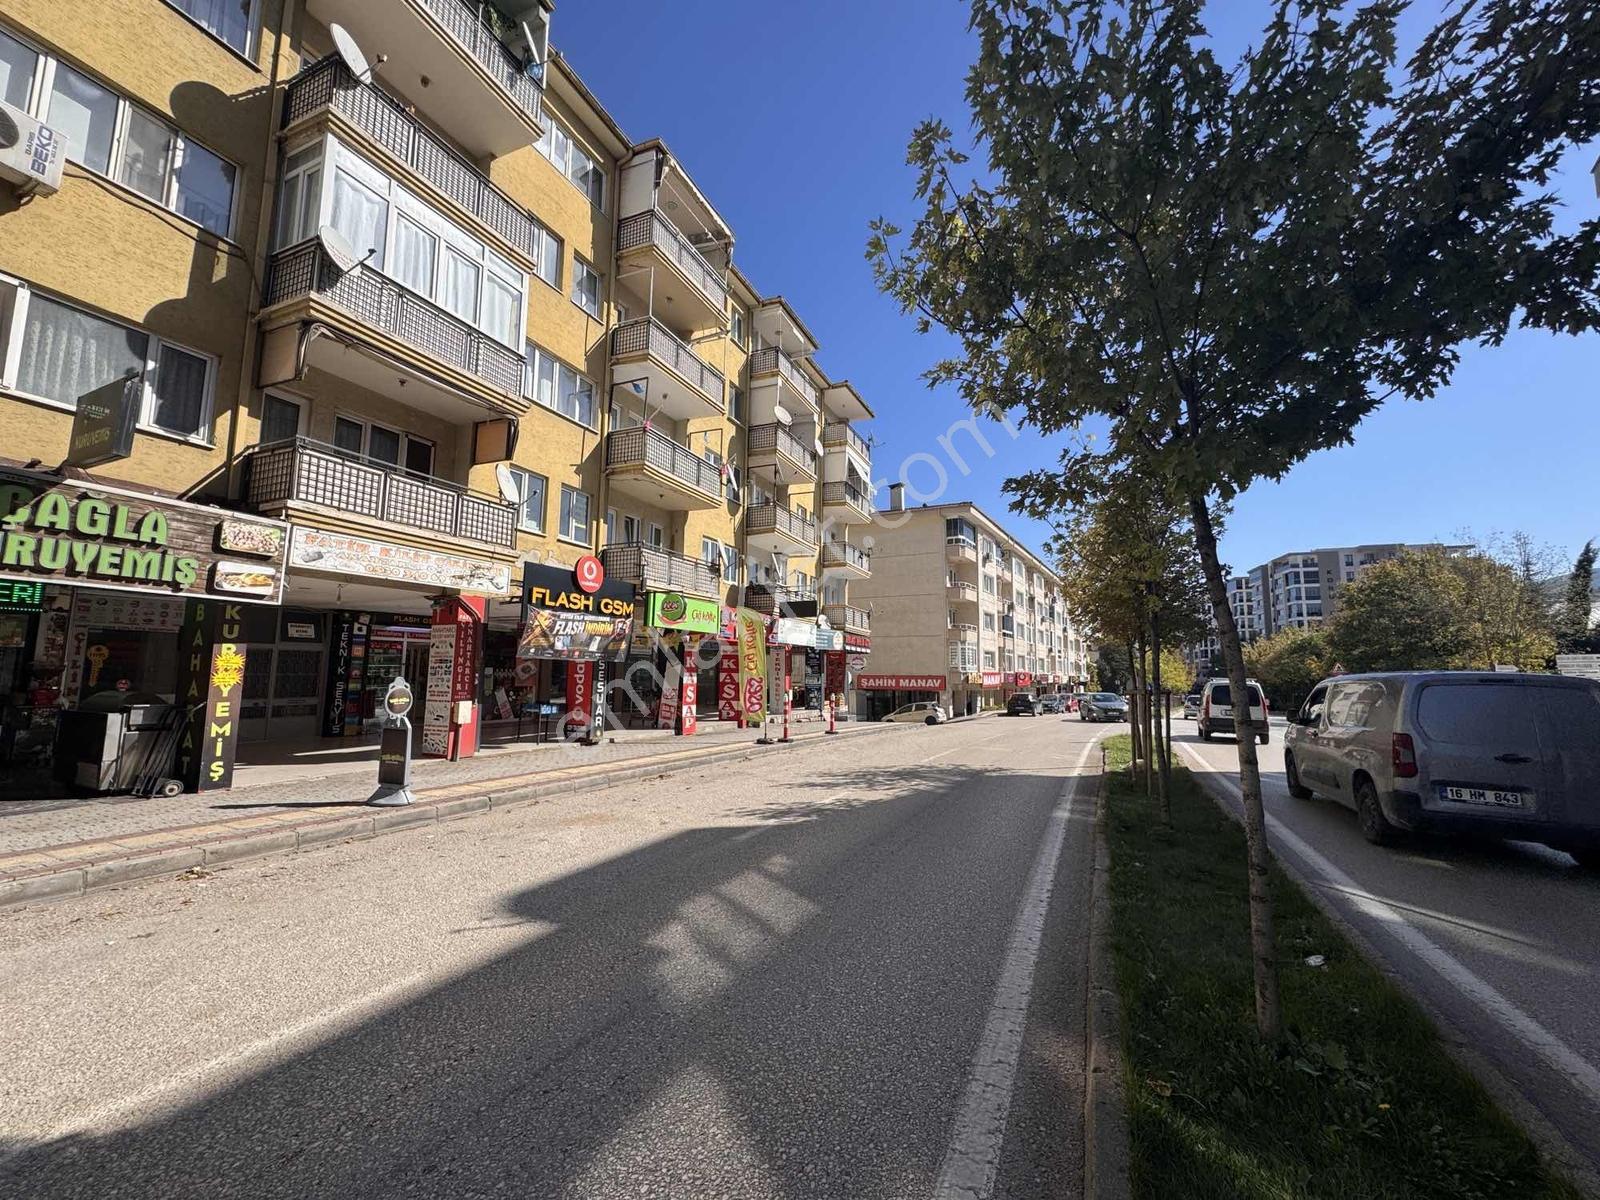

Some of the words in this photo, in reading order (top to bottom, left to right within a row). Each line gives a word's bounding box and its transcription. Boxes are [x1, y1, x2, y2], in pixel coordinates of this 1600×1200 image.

[30, 124, 54, 176] BEKO
[0, 531, 200, 591] RUYEMİŞ
[531, 586, 594, 612] FLASH
[600, 598, 634, 616] GSM
[552, 620, 586, 635] FLASH
[181, 603, 205, 775] BAHARAT
[209, 604, 242, 782] KURYEMİŞ
[573, 660, 586, 704] voda
[595, 658, 606, 727] SESUAR
[684, 656, 697, 728] KASAP
[721, 658, 738, 720] KASAP
[860, 675, 897, 689] ŞAHİN
[899, 678, 942, 689] MANAV
[1449, 788, 1463, 799] 16
[1493, 792, 1519, 804] 843
